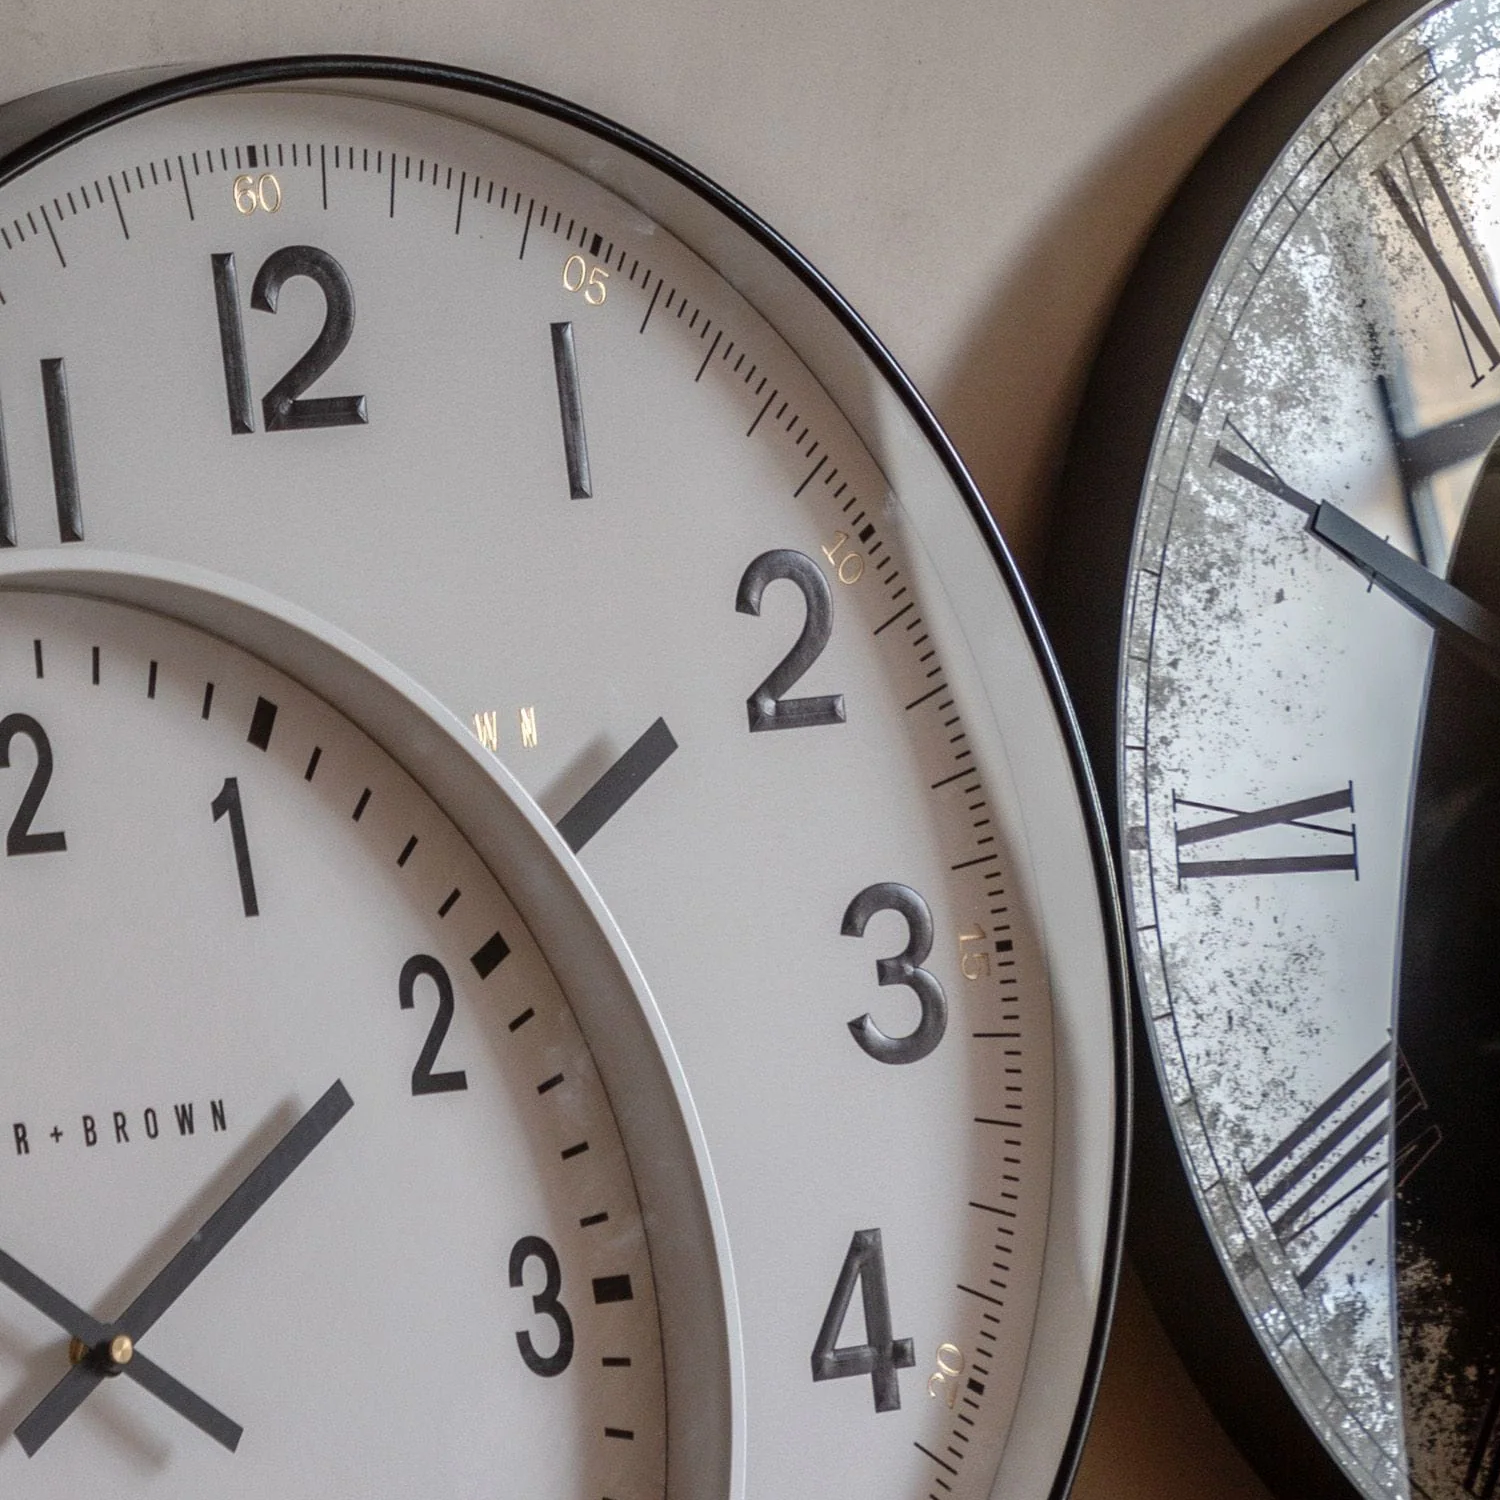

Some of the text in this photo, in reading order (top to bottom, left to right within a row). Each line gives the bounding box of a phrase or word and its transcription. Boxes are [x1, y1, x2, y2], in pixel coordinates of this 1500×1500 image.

[232, 173, 283, 215] 60
[211, 245, 369, 435] 12
[562, 253, 610, 307] 05
[550, 321, 593, 500] 1
[821, 529, 865, 586] 10
[735, 548, 846, 733] 2
[211, 777, 259, 918] 1
[1172, 780, 1359, 889] IX
[840, 882, 948, 1065] 3
[958, 922, 990, 981] 15
[399, 954, 468, 1096] 2
[508, 1235, 574, 1378] 3
[810, 1228, 916, 1414] 4
[927, 1342, 965, 1410] 20
